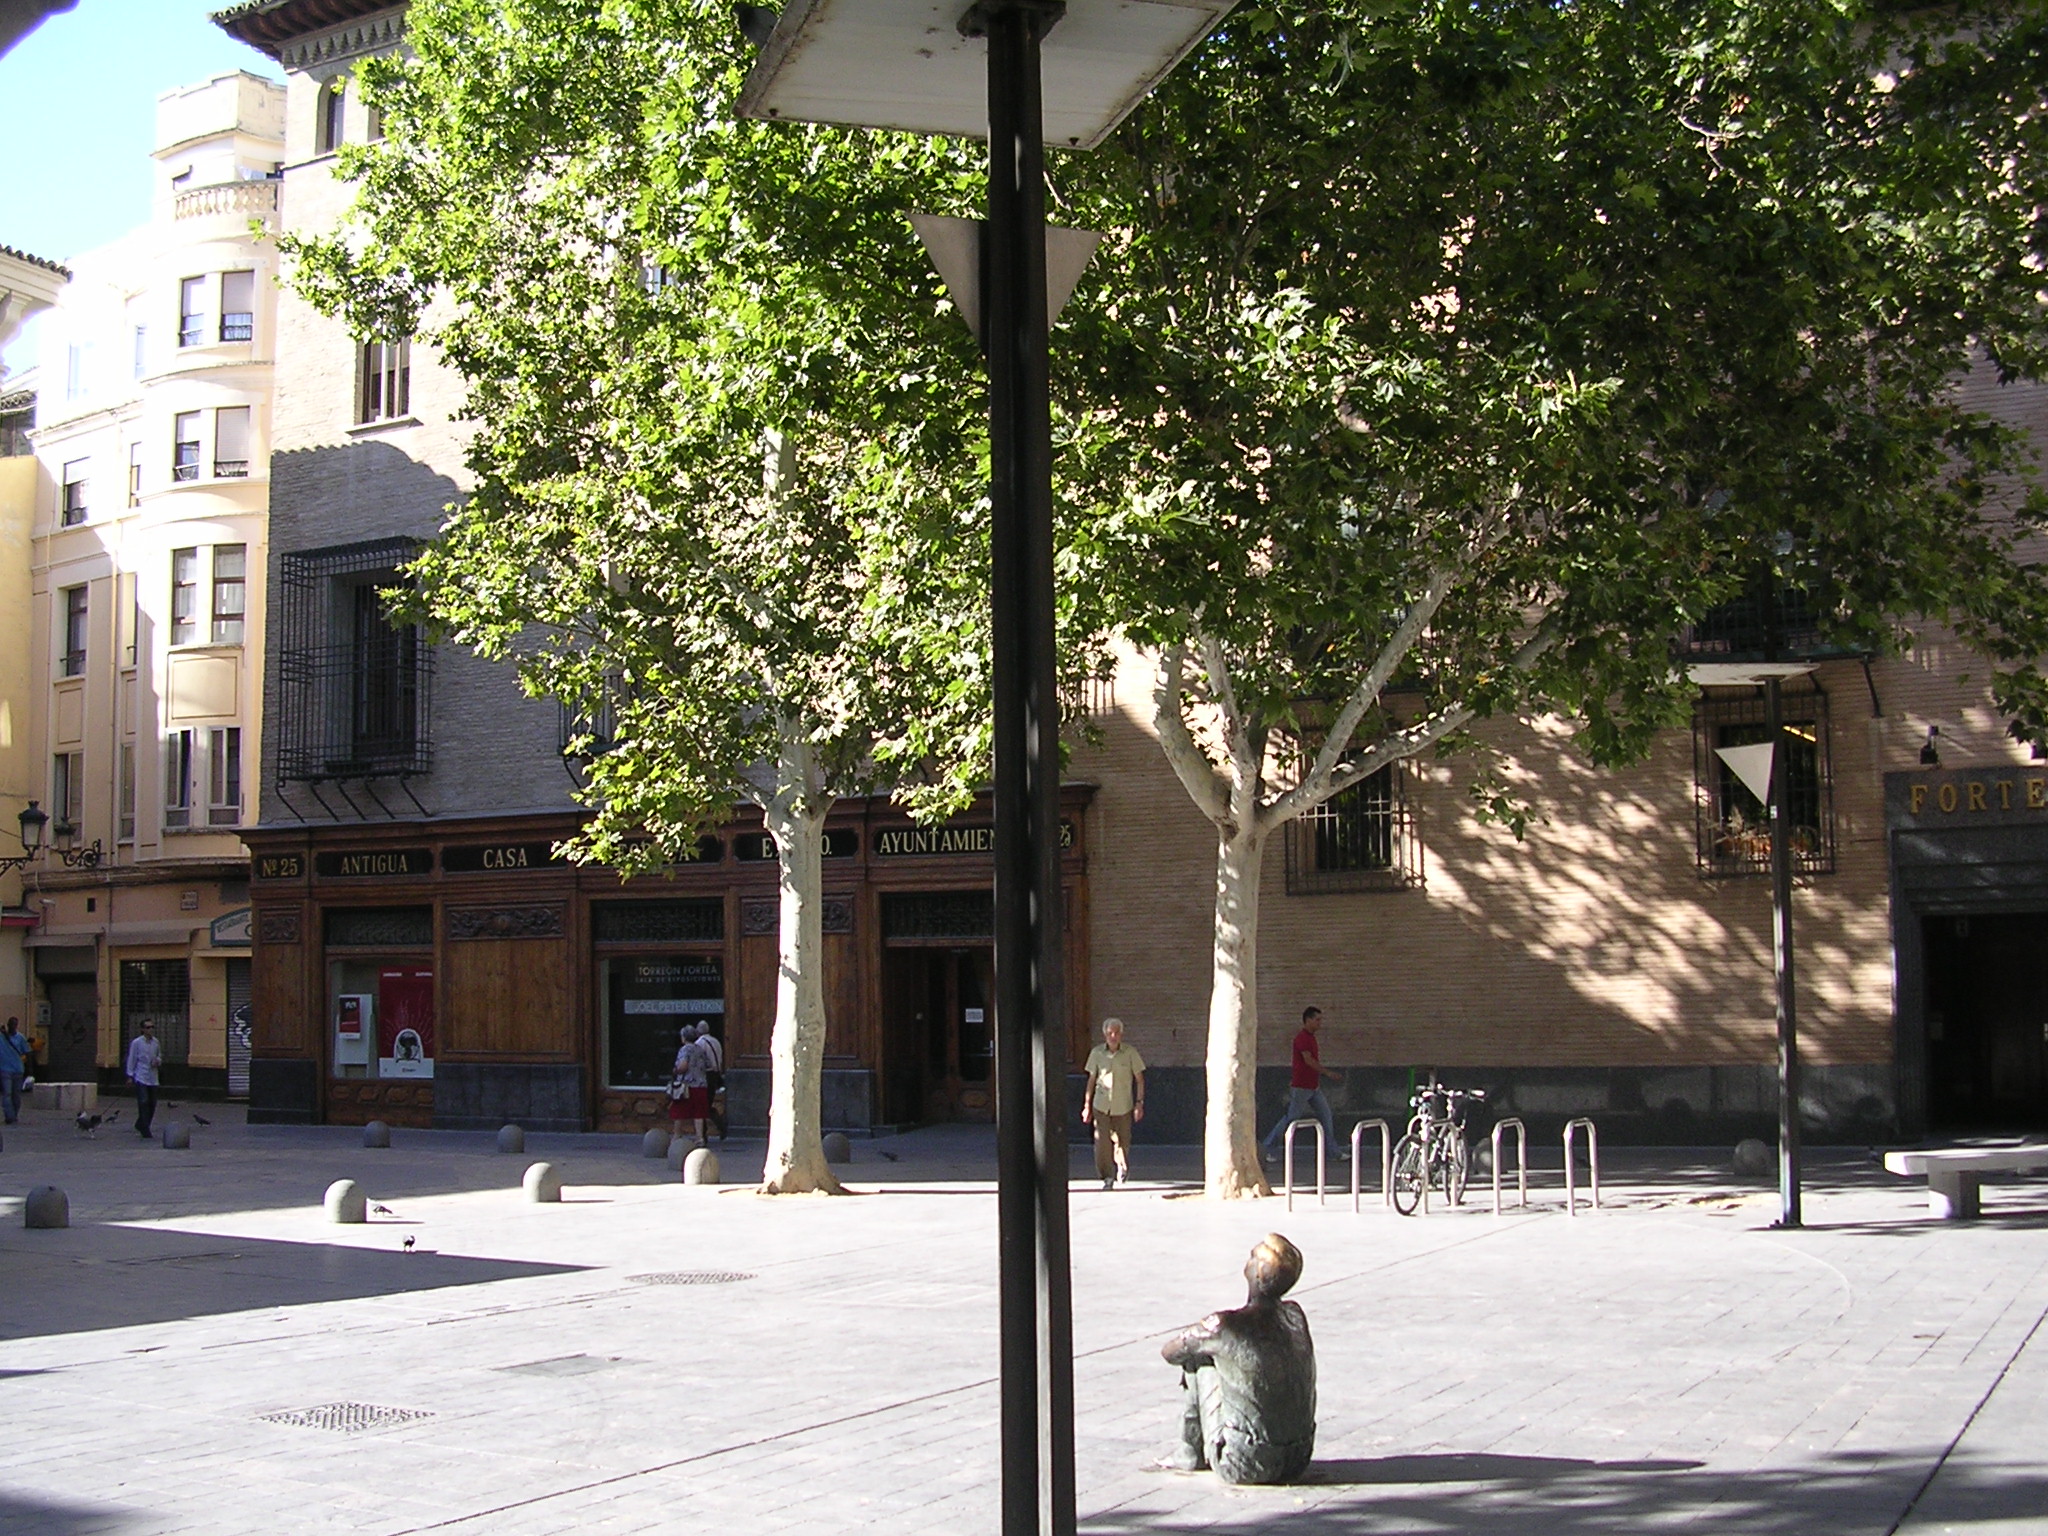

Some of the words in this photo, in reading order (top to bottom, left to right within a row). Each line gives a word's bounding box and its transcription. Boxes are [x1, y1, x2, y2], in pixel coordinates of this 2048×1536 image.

[1909, 778, 2046, 815] FORTE
[879, 829, 994, 853] AYUNTAMIE
[280, 857, 298, 876] 25
[340, 854, 408, 874] ANTIGUA
[483, 847, 528, 869] CASA
[659, 1002, 688, 1012] PETER
